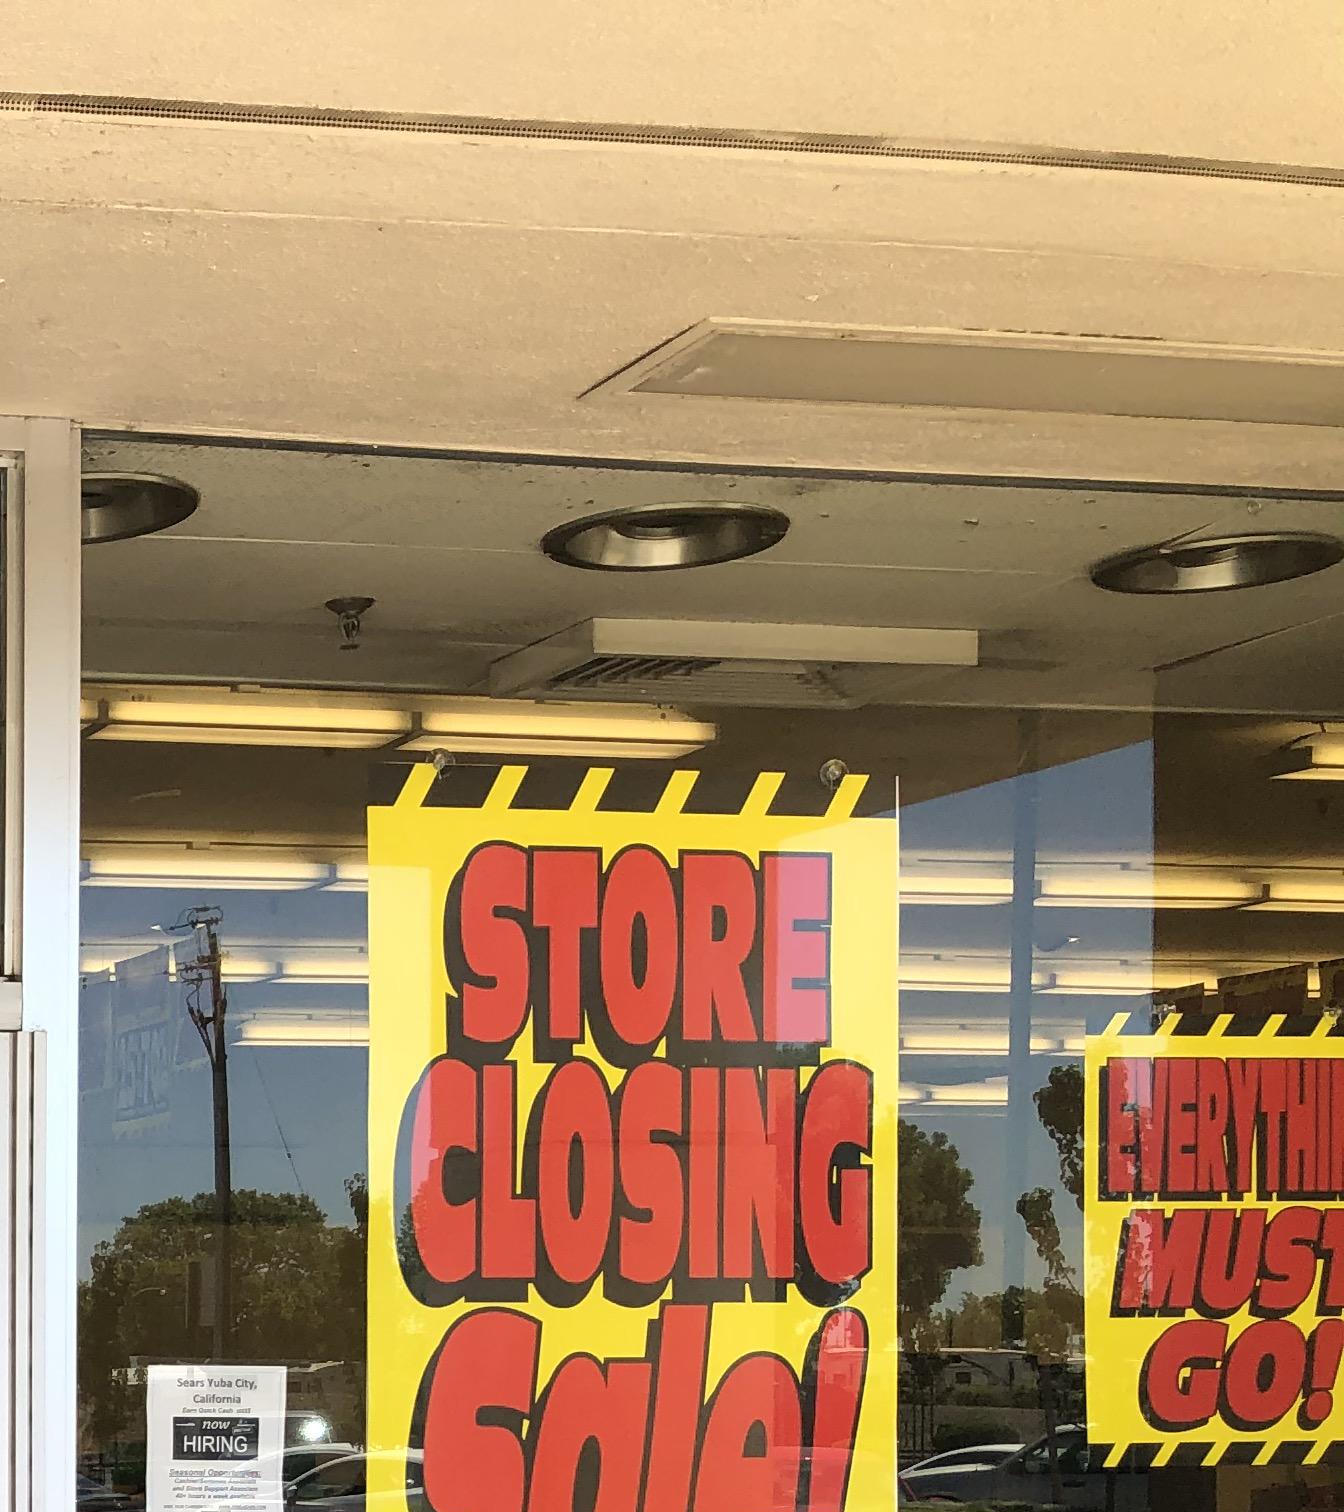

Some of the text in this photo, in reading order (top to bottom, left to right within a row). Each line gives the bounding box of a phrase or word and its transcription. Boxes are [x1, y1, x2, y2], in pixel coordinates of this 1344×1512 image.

[443, 840, 833, 1066] STORE
[393, 1054, 875, 1307] CLOSING
[177, 1378, 257, 1390] Sears Yuba City,
[1139, 1319, 1344, 1434] GO!
[193, 1394, 241, 1404] California
[202, 1420, 230, 1430] now
[183, 1435, 248, 1453] HIRING
